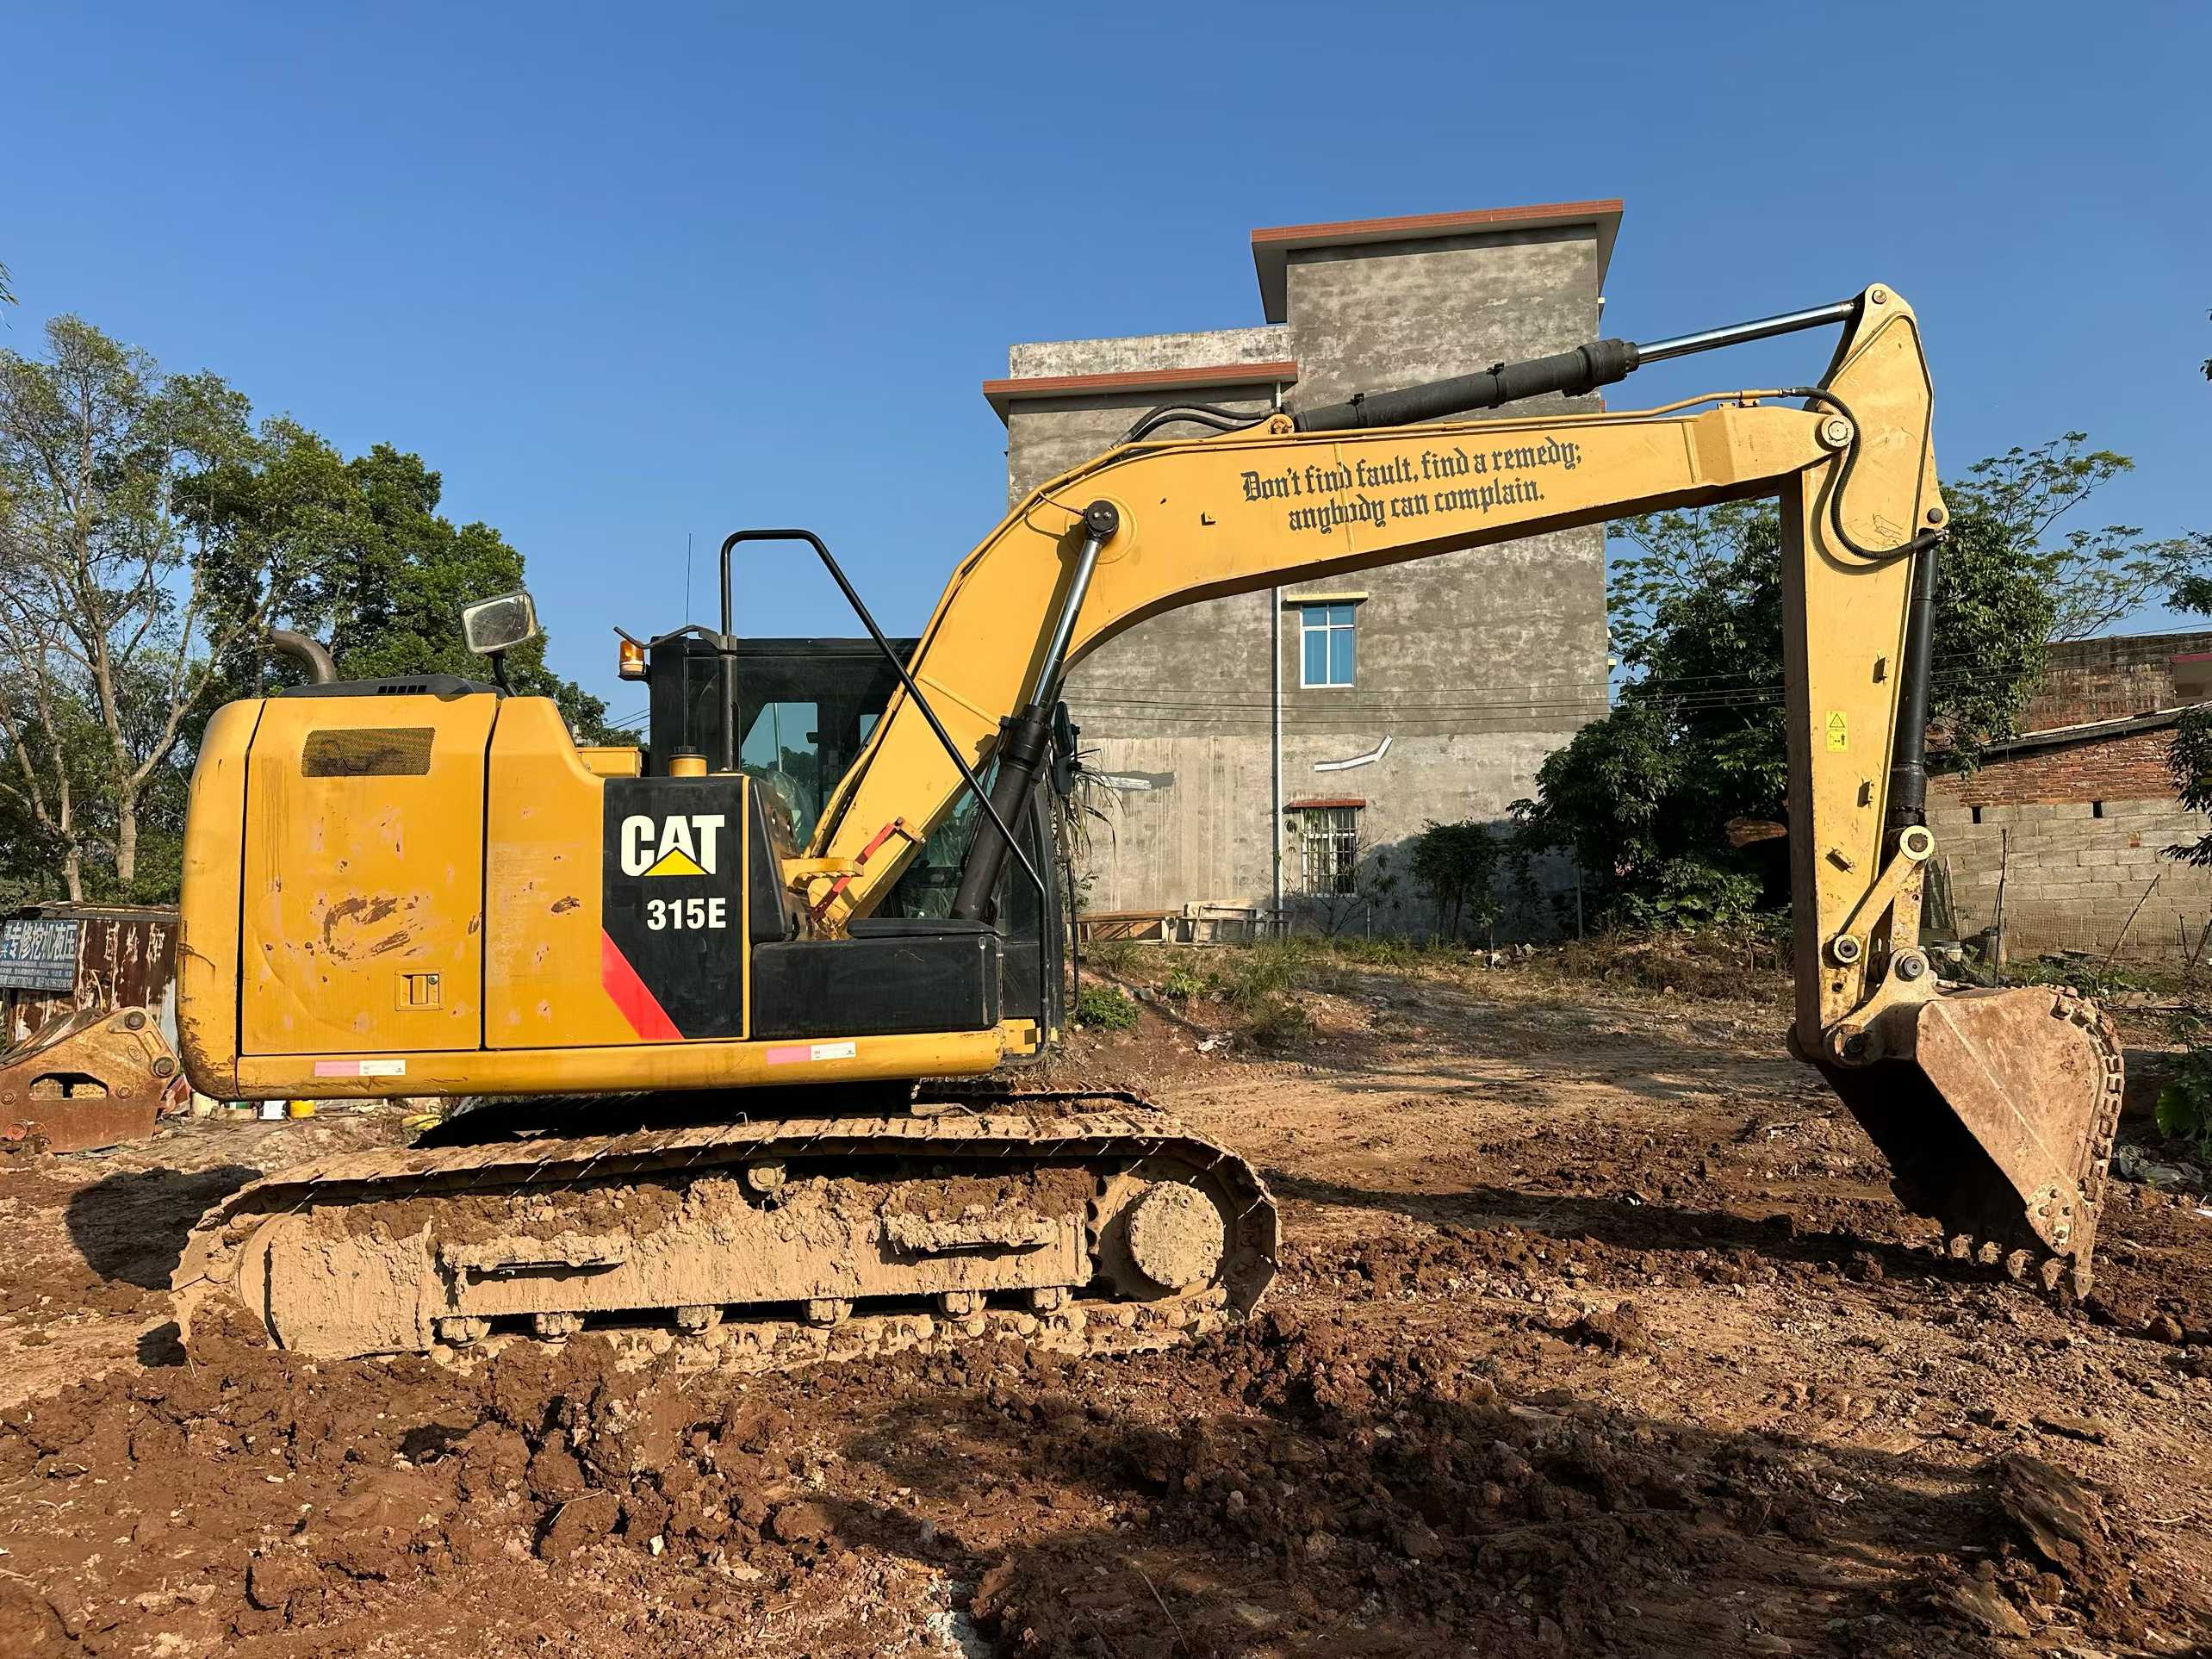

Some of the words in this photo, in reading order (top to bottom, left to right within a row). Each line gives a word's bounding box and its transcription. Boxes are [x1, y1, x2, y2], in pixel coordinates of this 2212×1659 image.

[1240, 467, 1302, 502] Don't
[1305, 462, 1352, 494] find
[1356, 455, 1419, 488] fault,
[1420, 447, 1469, 480] find
[1473, 452, 1488, 474] a
[1491, 436, 1581, 471] remedy;
[1288, 494, 1386, 534] anybody
[1391, 493, 1429, 518] can
[1434, 477, 1545, 514] complain.
[620, 814, 725, 877] CAT
[9, 922, 77, 961] 专修挖机液压
[647, 898, 726, 930] 315E
